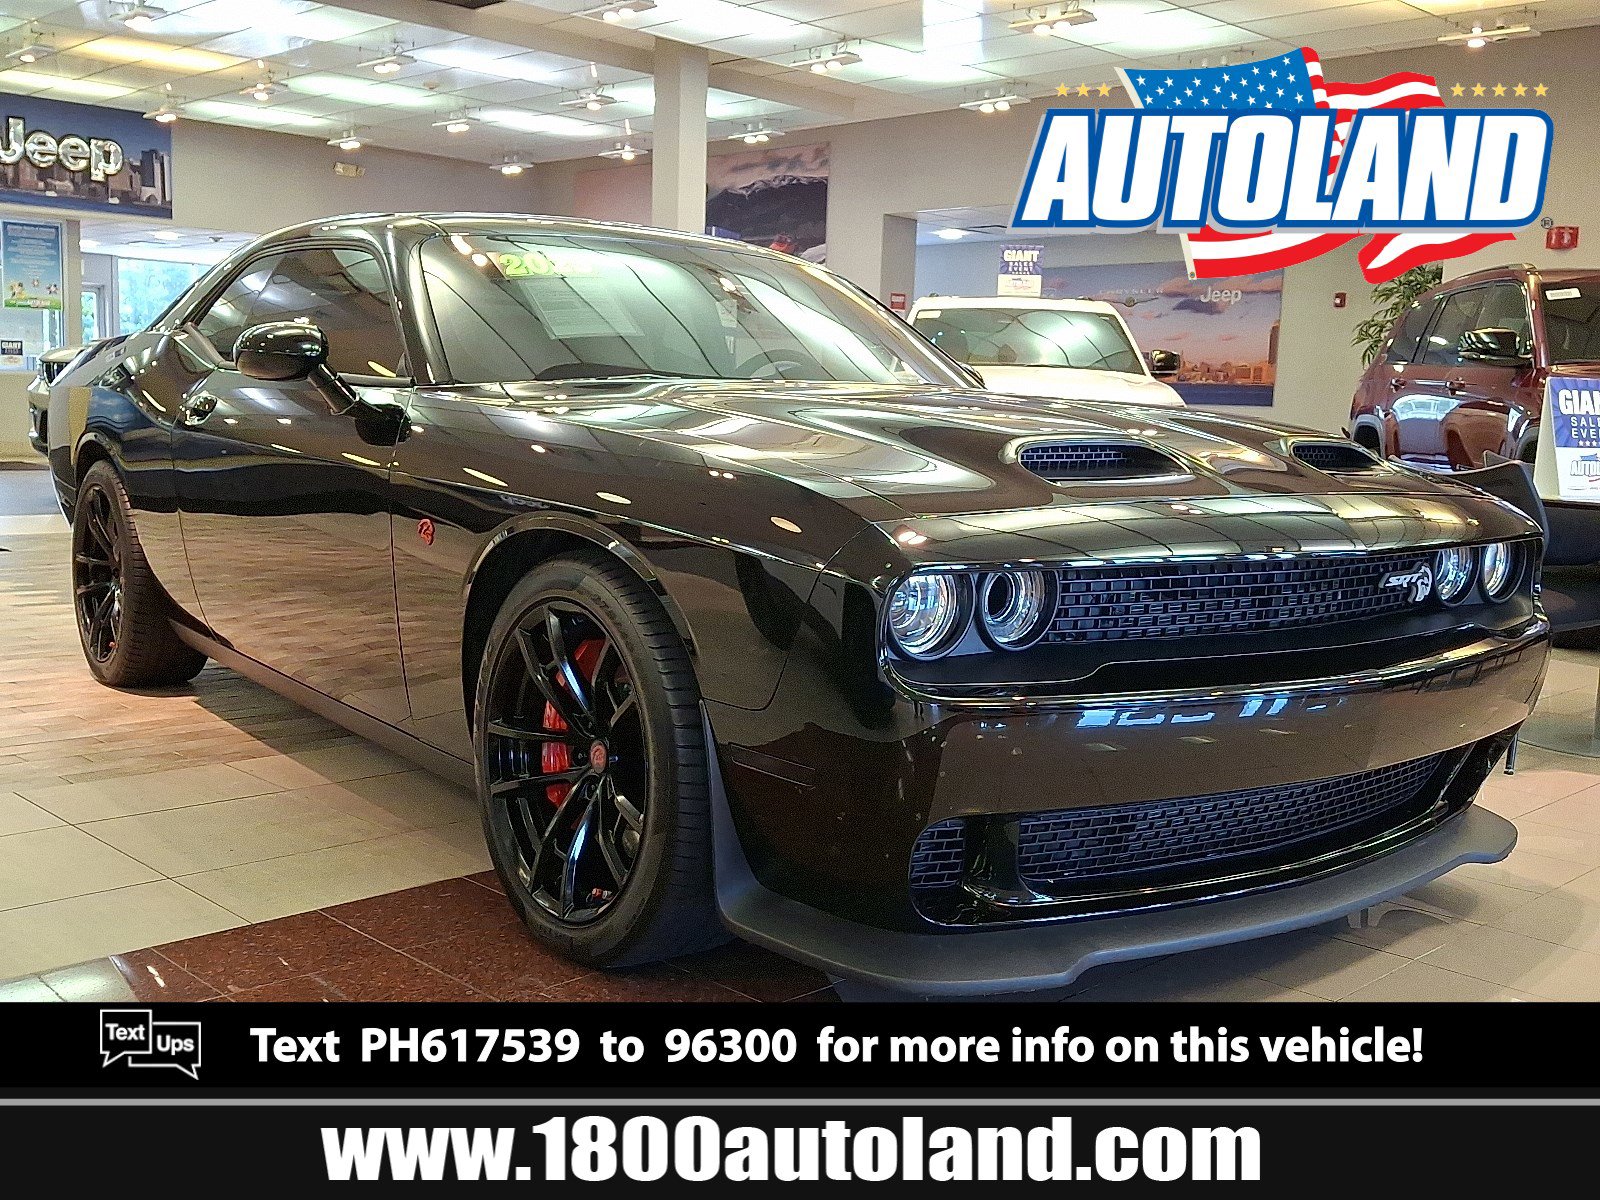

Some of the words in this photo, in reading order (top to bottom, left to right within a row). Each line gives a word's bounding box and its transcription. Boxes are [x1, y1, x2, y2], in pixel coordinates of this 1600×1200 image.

[0, 116, 123, 182] Jeep
[1003, 249, 1040, 262] GIANT
[1200, 286, 1242, 305] Jeep
[1571, 428, 1600, 439] EVE
